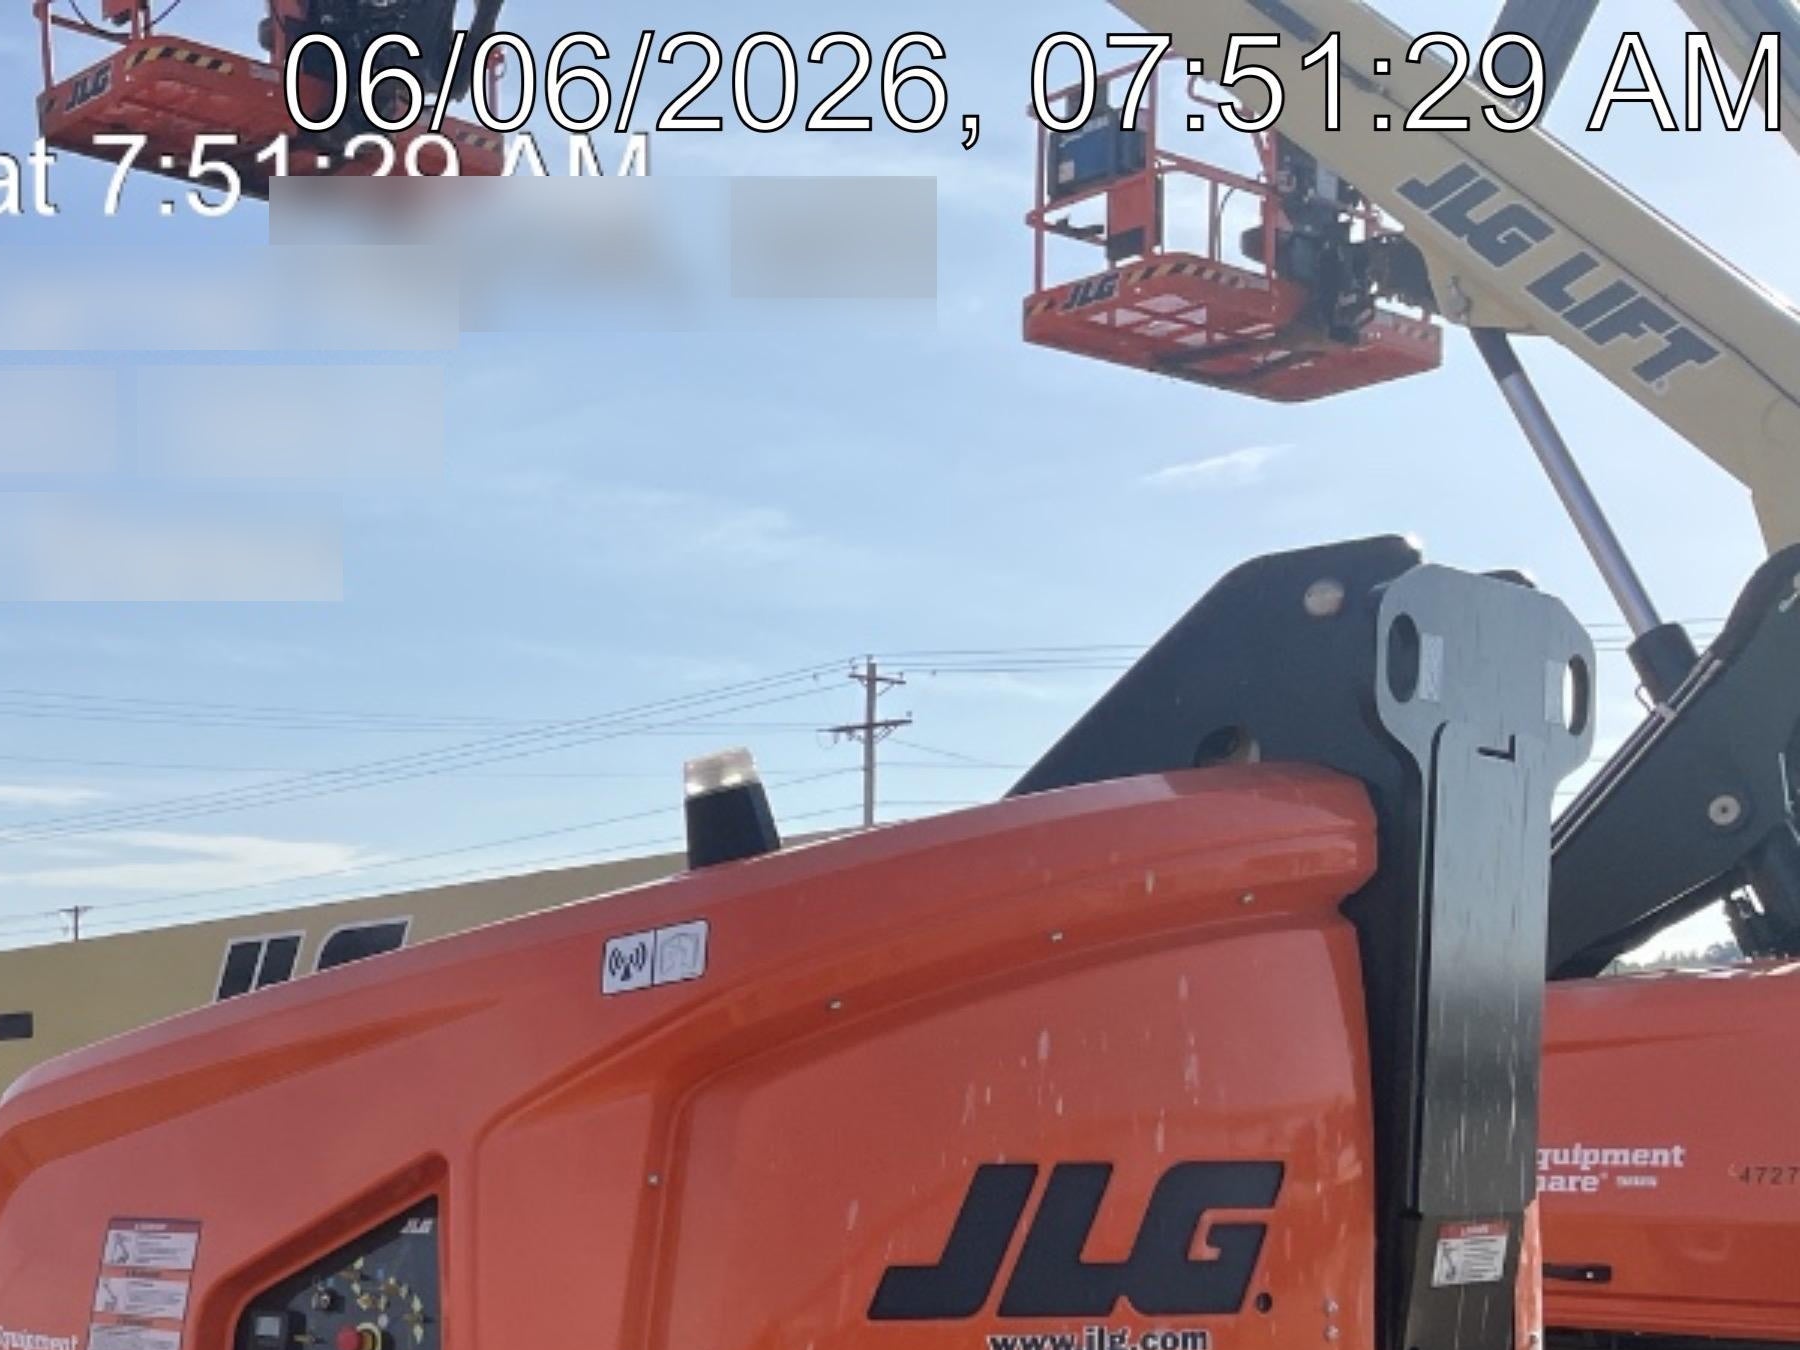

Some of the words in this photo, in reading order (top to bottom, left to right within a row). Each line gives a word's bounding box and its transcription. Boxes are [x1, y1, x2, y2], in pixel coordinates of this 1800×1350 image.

[1395, 160, 1555, 268] JLG
[1524, 250, 1721, 384] LIFT
[1537, 1143, 1686, 1170] quipment
[866, 1160, 1286, 1320] JLG
